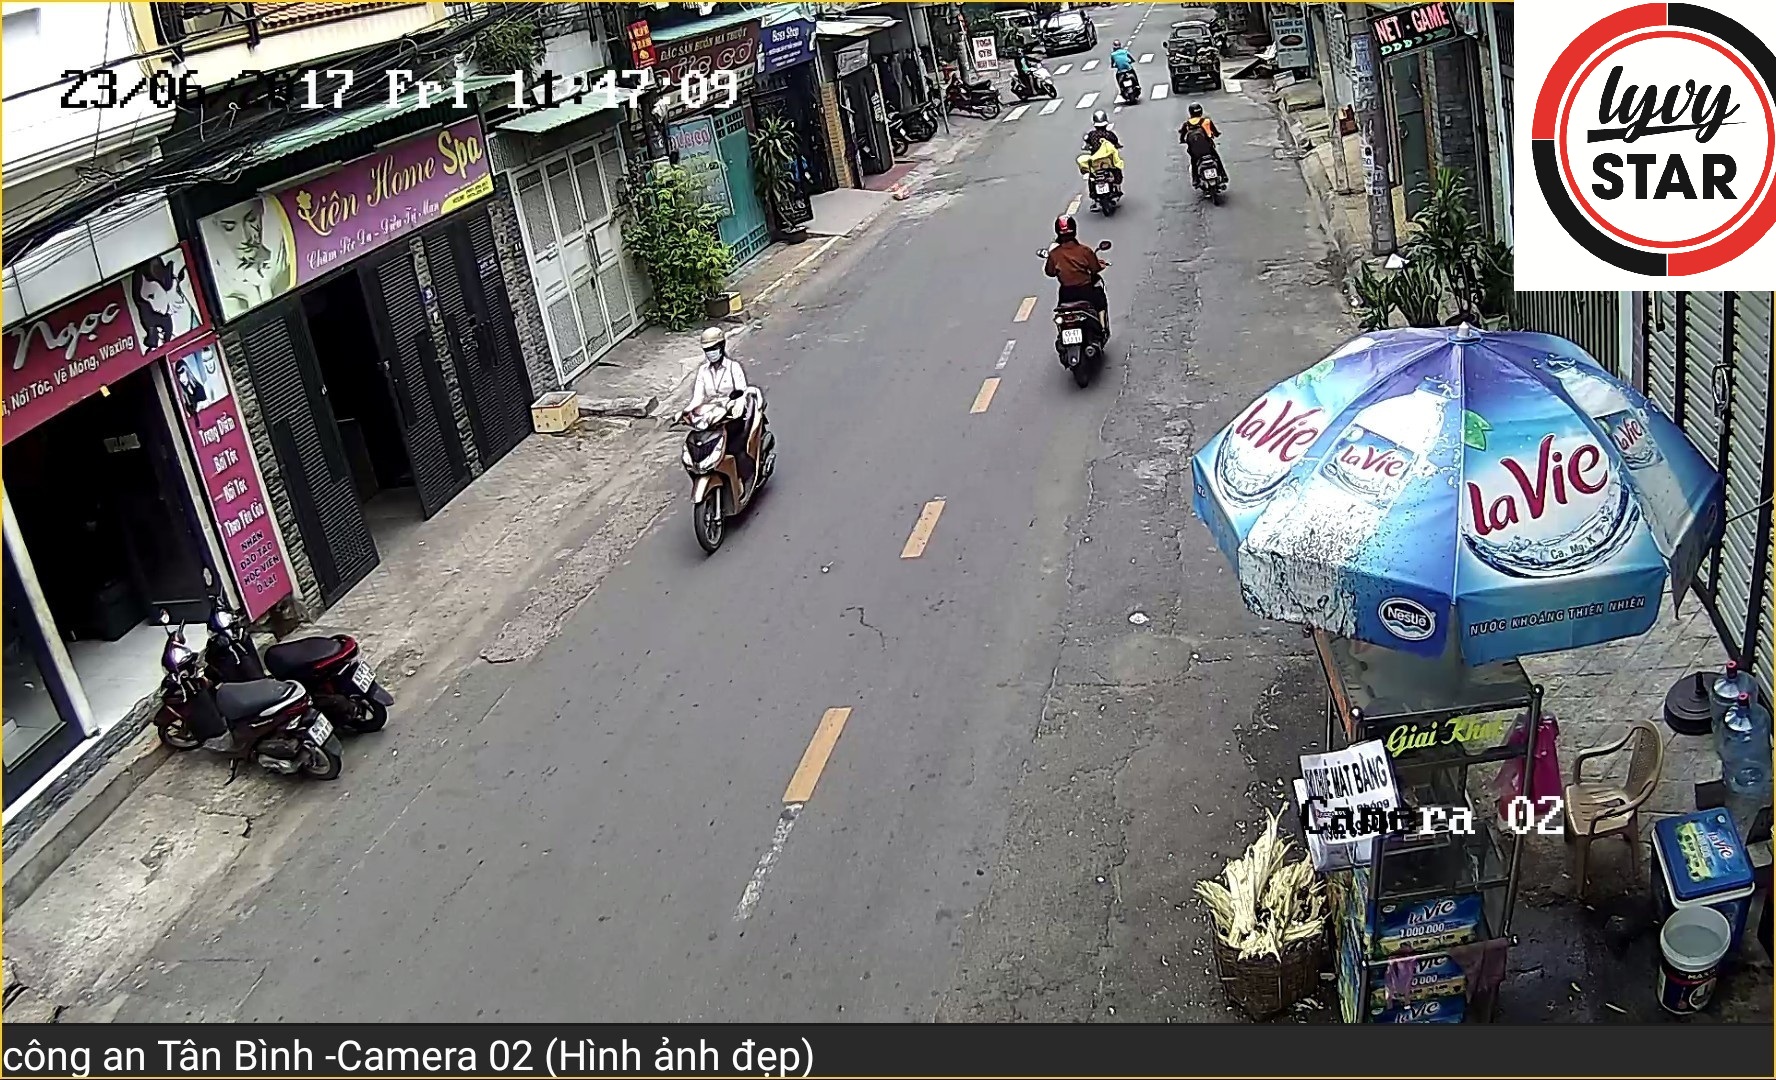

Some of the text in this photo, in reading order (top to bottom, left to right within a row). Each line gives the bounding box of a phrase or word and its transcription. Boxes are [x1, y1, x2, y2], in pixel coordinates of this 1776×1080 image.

[1374, 2, 1450, 44] NET GAME
[975, 38, 992, 48] YOGA
[367, 154, 436, 207] Home
[437, 130, 483, 179] Spa
[11, 302, 120, 370] Ngọc
[53, 367, 68, 386] Vẽ
[98, 335, 134, 361] Waxing
[1586, 534, 1596, 545] K
[1387, 605, 1427, 627] Nestlé
[1567, 602, 1604, 620] THIÊN
[1608, 596, 1645, 613] NHIÊN
